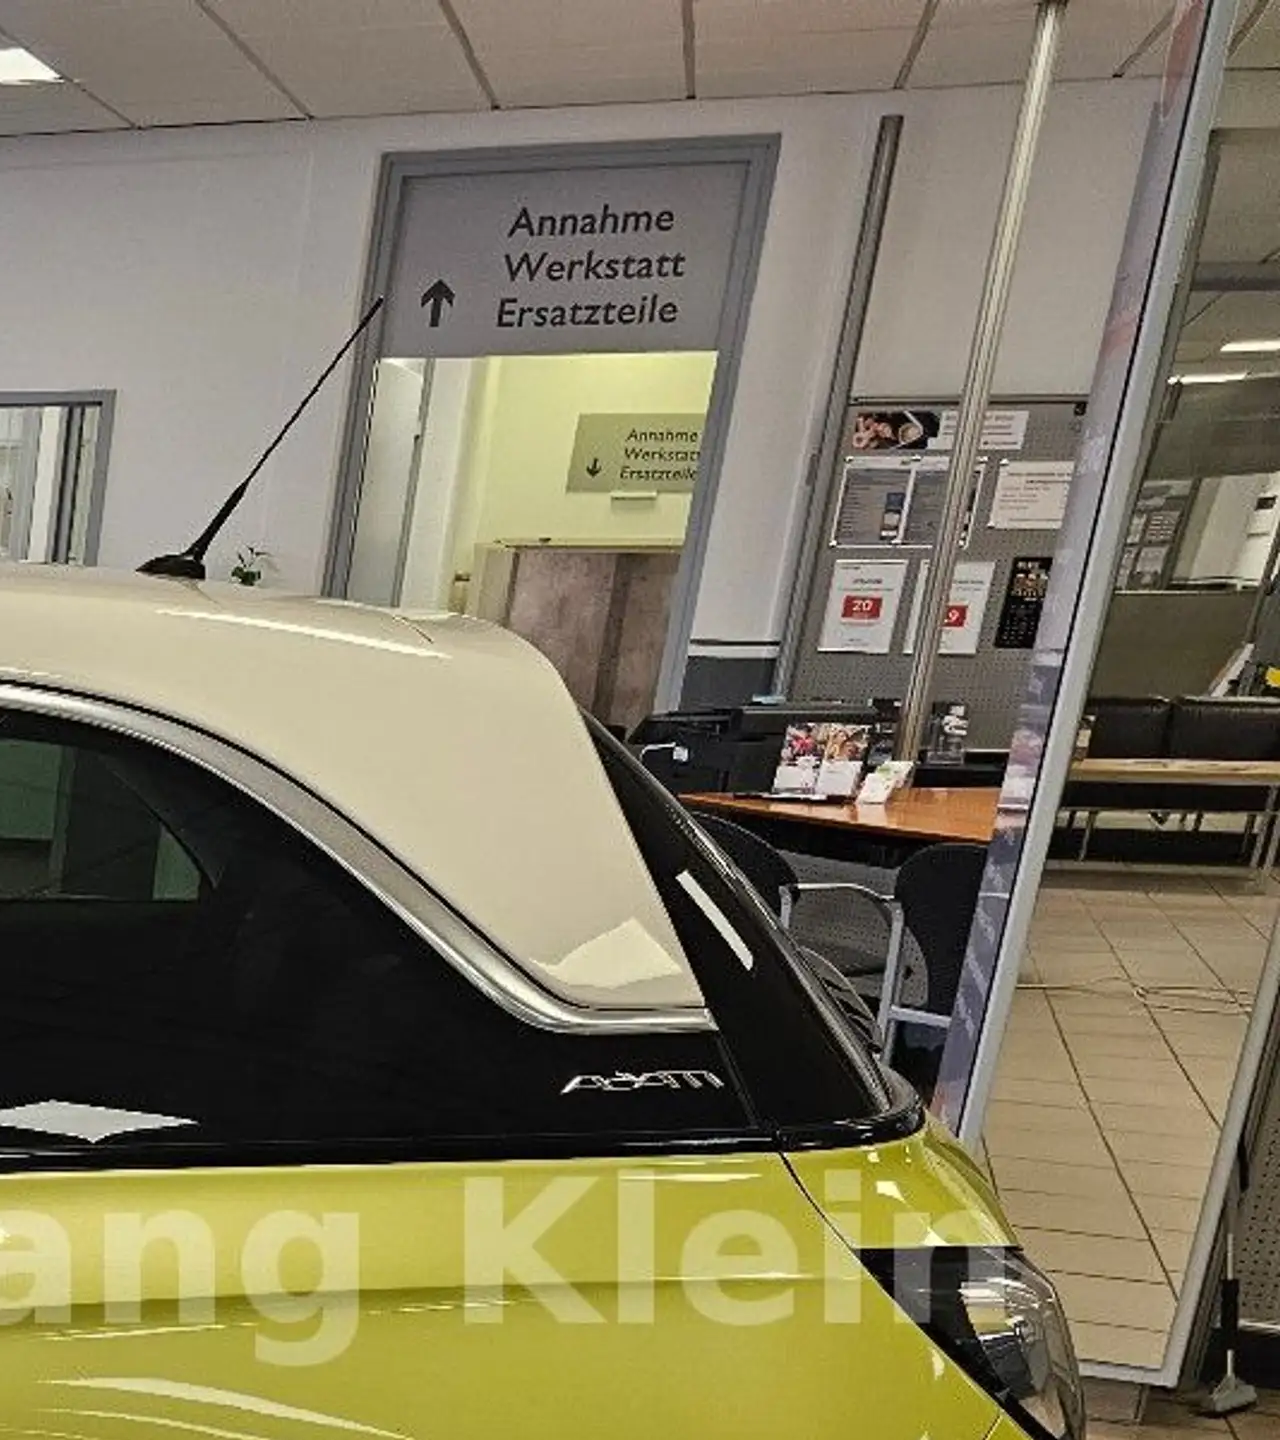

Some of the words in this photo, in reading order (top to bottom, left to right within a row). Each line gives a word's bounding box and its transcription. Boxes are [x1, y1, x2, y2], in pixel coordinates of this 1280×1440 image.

[507, 203, 676, 239] Annahme
[504, 250, 687, 283] Werkstatt
[496, 293, 679, 328] Ersatzteile
[625, 427, 699, 443] Annahme
